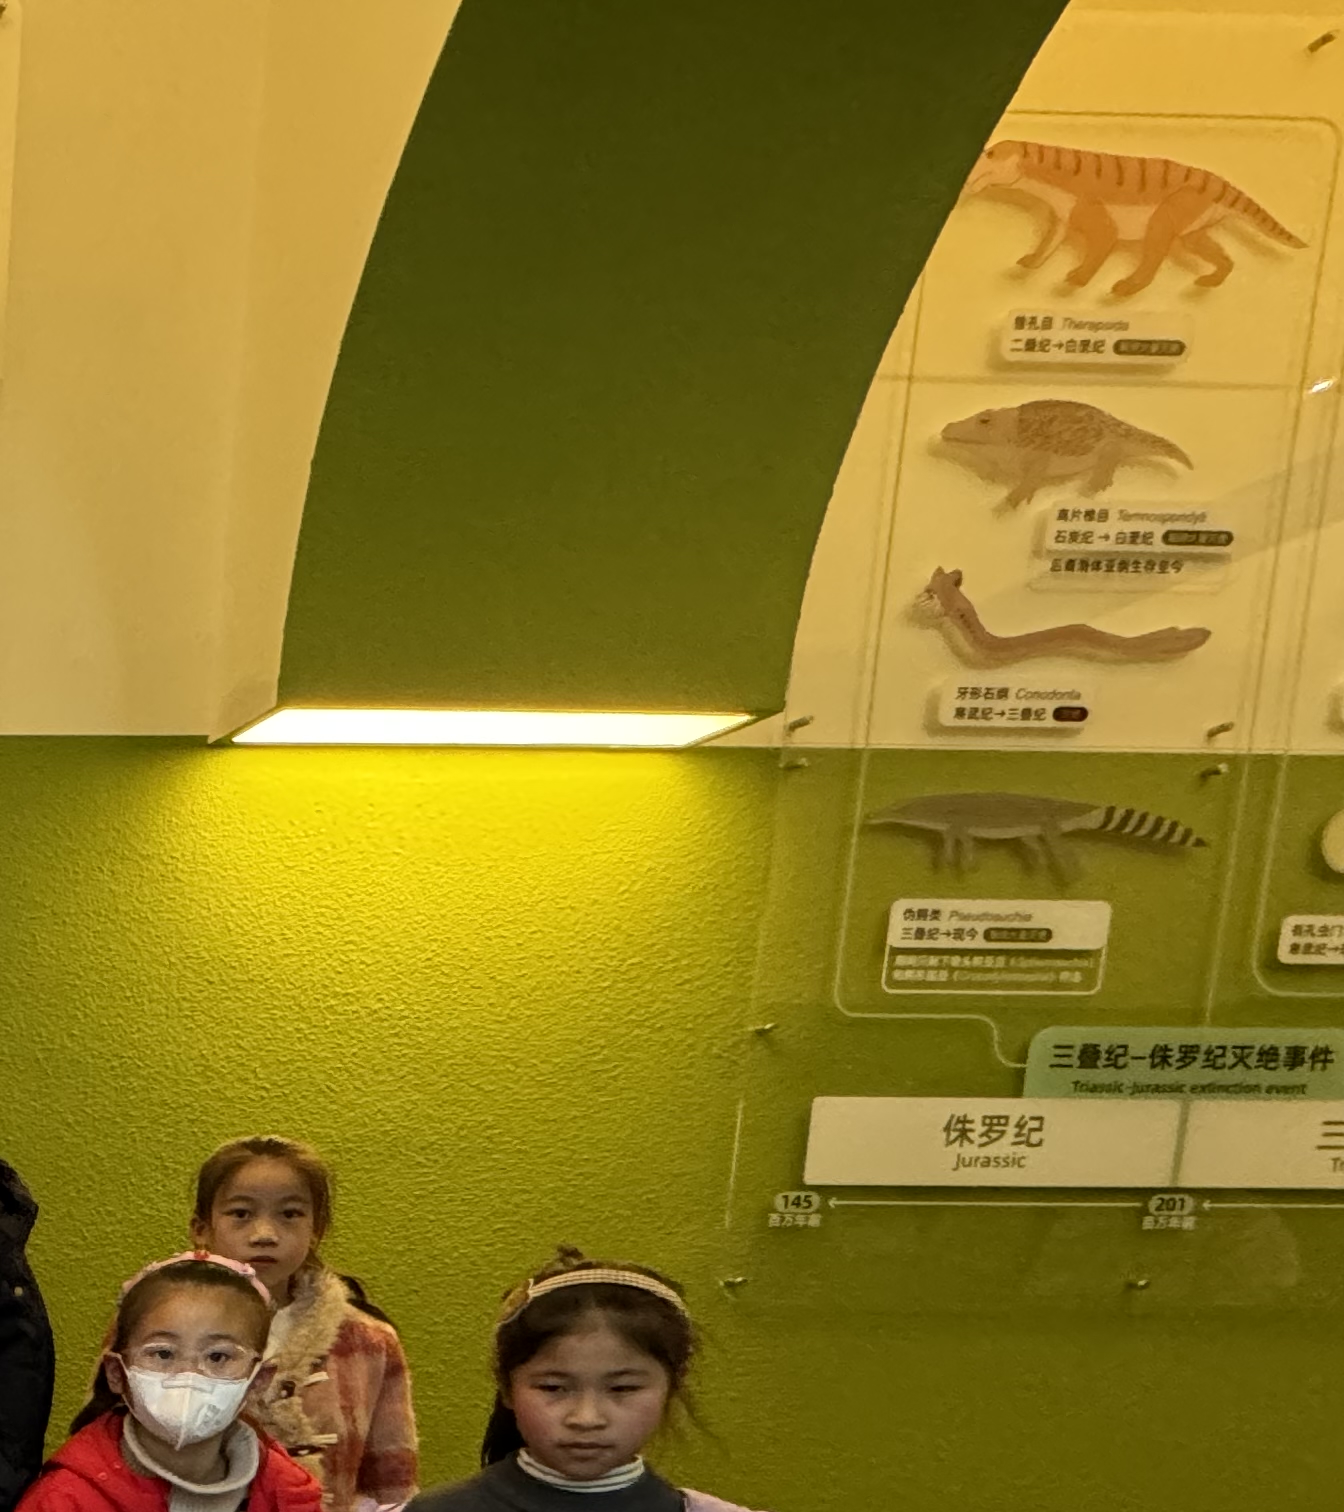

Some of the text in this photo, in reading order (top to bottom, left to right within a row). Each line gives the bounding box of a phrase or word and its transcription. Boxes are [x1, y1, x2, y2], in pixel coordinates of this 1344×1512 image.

[943, 1114, 1044, 1148] 侏罗纪
[952, 1153, 1026, 1171] Jurassic
[781, 1194, 813, 1209] 145
[1155, 1198, 1184, 1211] 201
